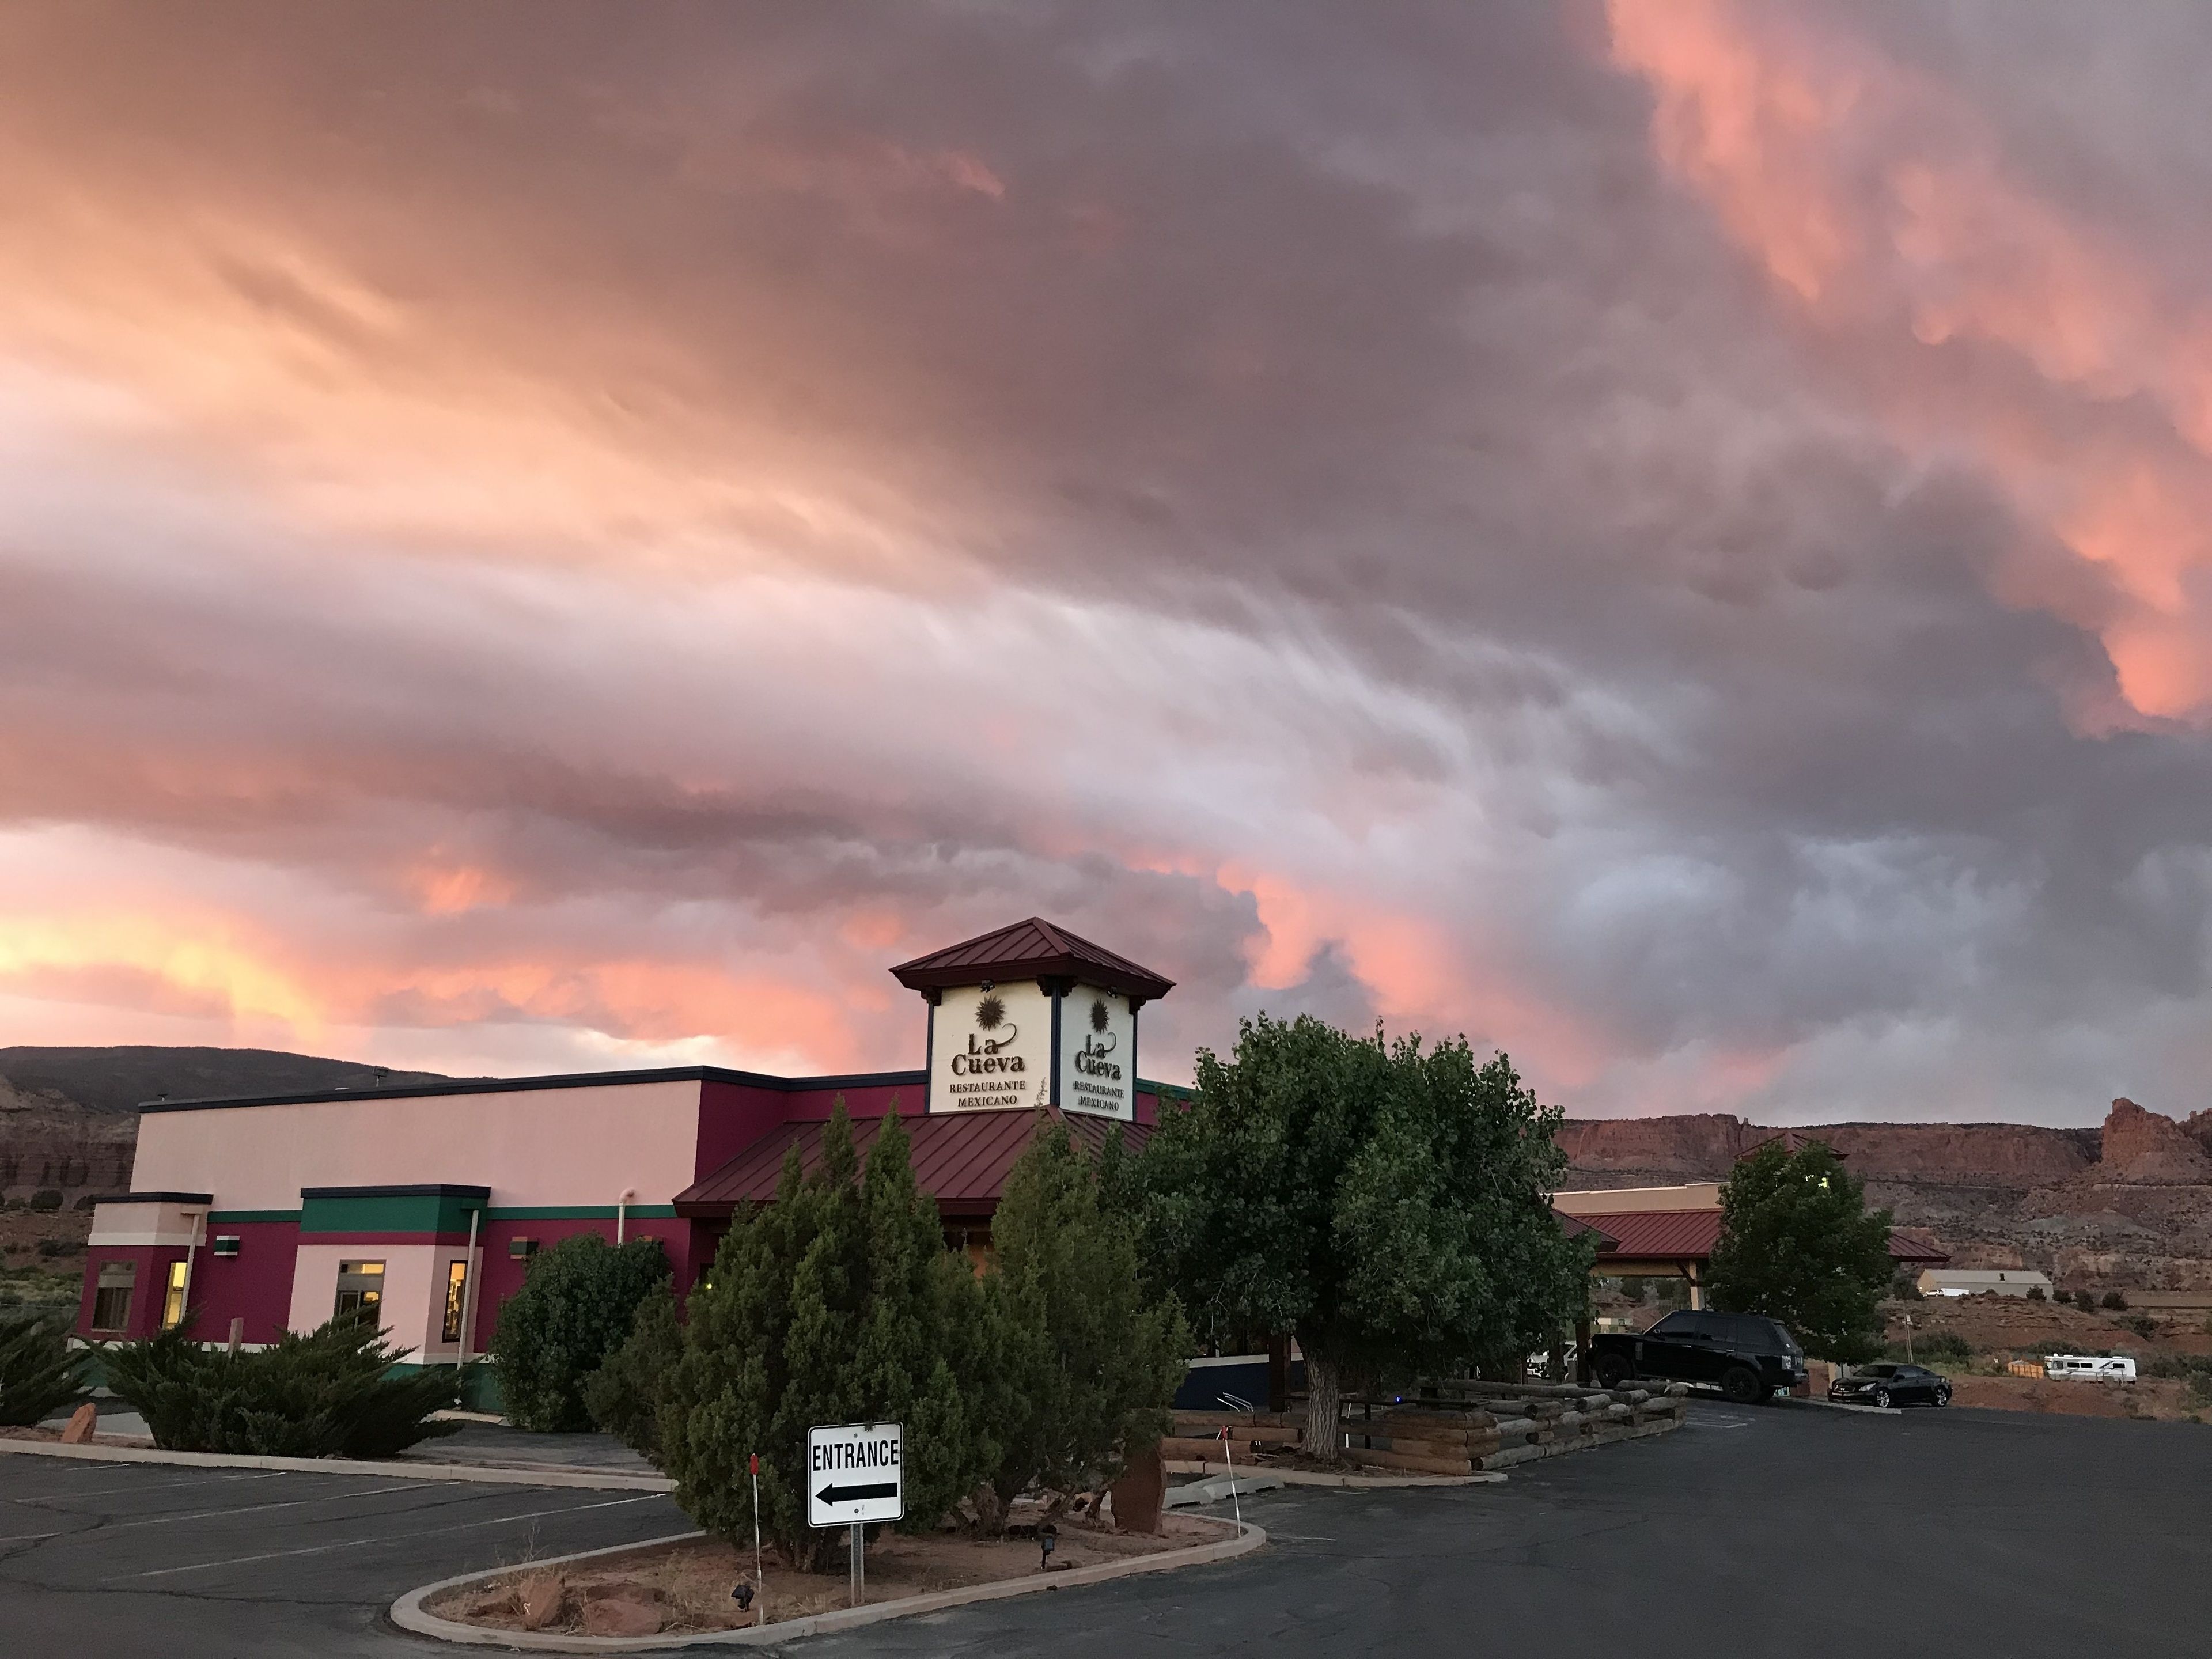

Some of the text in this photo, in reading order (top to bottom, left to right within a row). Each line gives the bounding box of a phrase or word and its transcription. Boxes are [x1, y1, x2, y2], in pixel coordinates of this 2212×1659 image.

[968, 1023, 1017, 1055] La
[1085, 1032, 1116, 1059] La
[951, 1054, 1025, 1076] Cueva
[1075, 1051, 1122, 1080] Cueva
[950, 1081, 1025, 1093] RESTAURANTE
[1074, 1081, 1124, 1099] RESTAURANTE
[959, 1095, 1017, 1107] MEXICANO
[1079, 1096, 1119, 1111] MEXICANO
[813, 1440, 899, 1471] ENTRANCE
